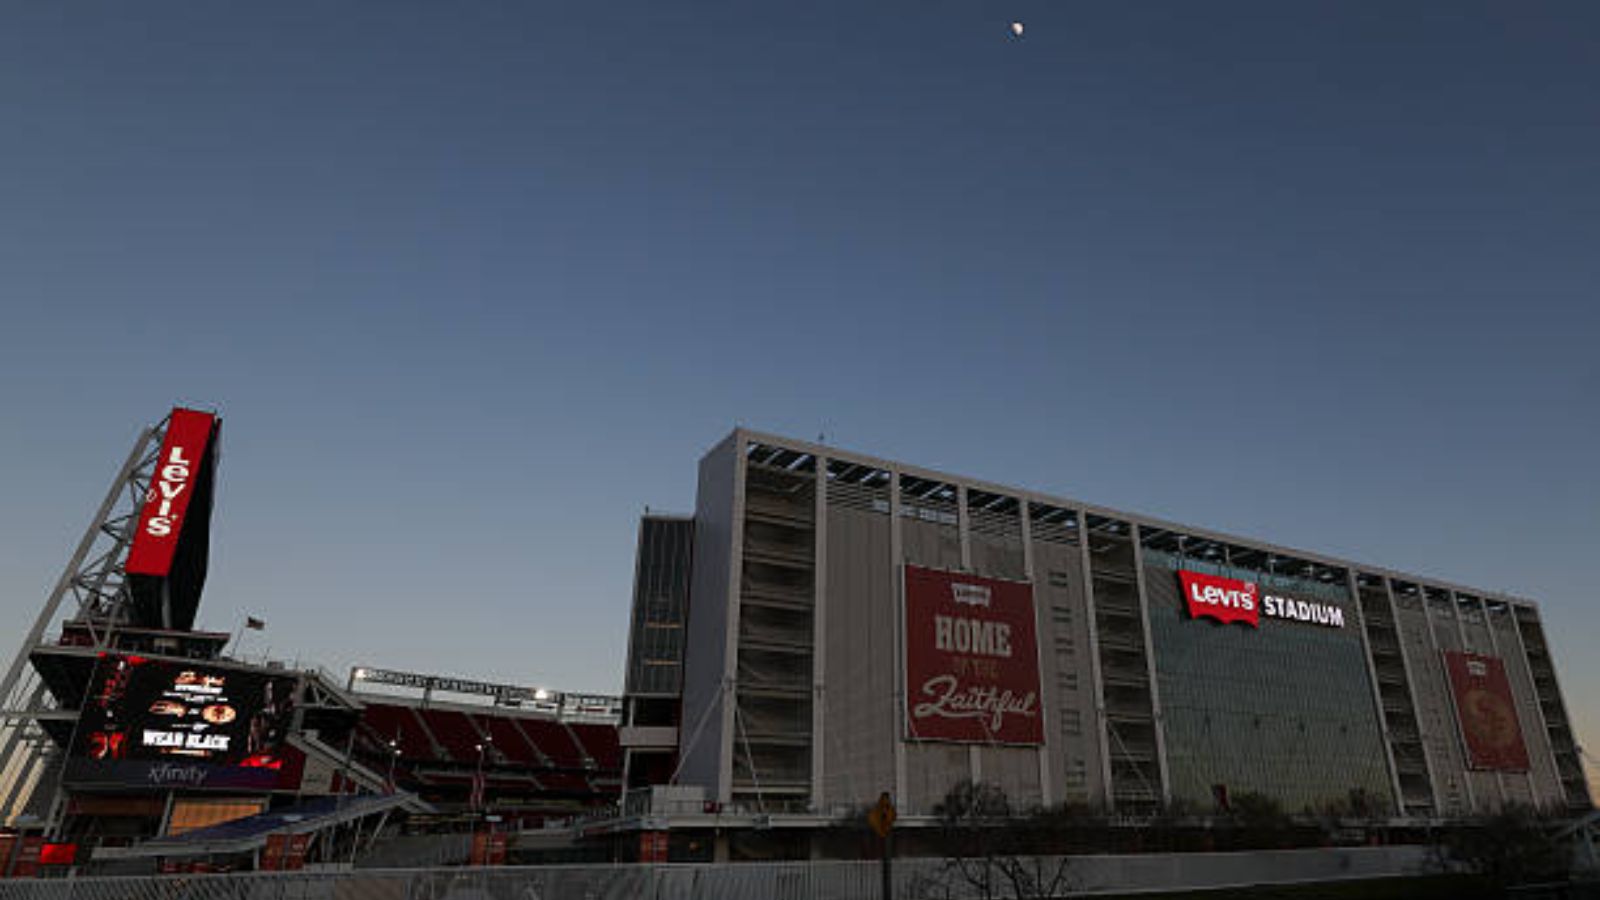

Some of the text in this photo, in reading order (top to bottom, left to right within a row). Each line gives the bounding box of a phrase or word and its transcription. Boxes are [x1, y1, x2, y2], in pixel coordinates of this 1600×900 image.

[1264, 595, 1344, 628] STADIUM
[934, 614, 1013, 657] HOME
[914, 674, 1037, 733] Faithful
[143, 729, 184, 746] WEAR
